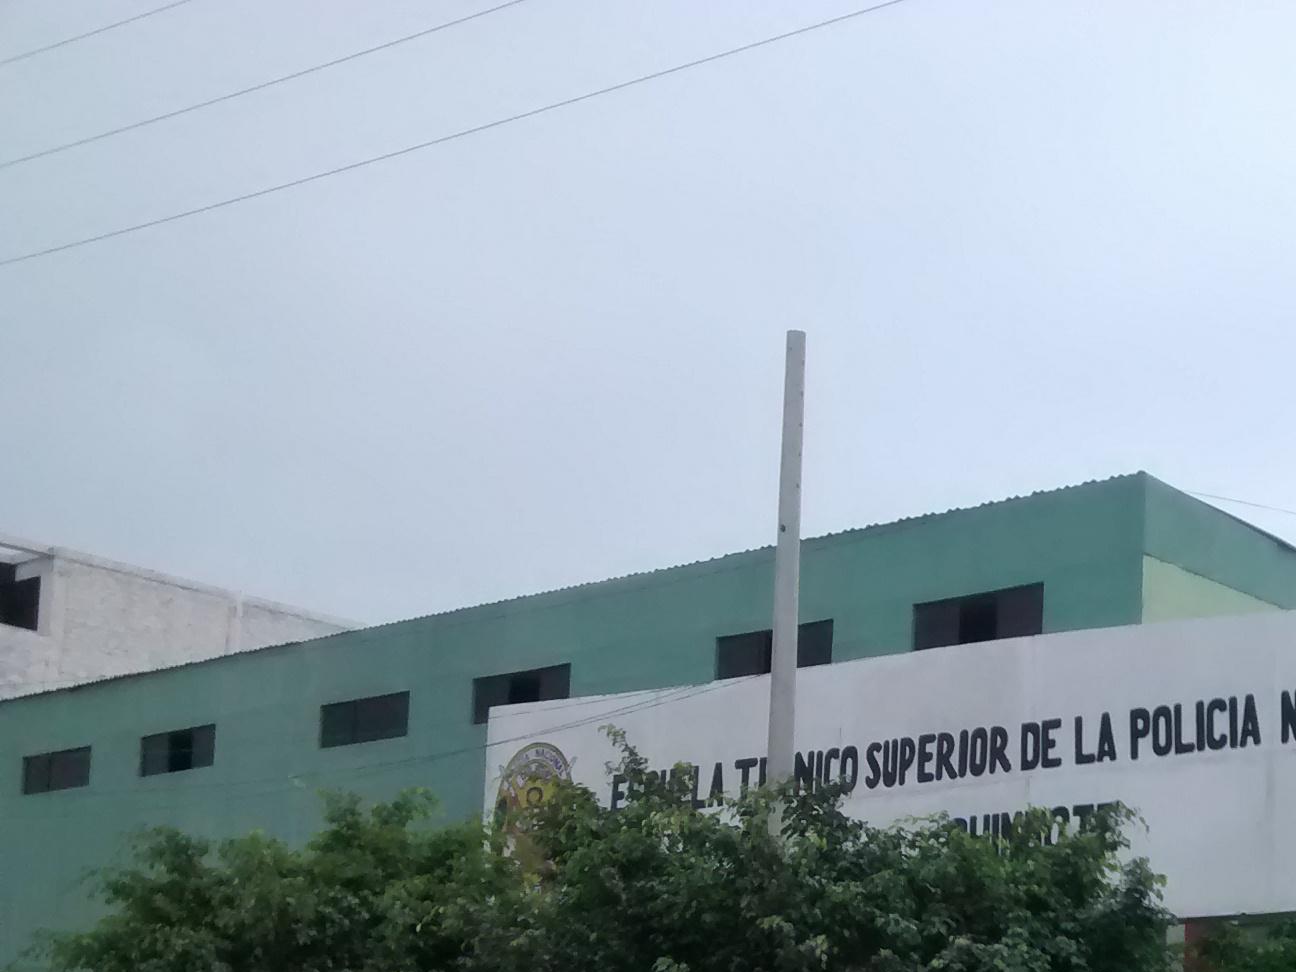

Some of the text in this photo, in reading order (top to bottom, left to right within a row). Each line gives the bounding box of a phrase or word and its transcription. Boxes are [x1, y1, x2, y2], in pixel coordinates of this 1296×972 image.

[734, 744, 859, 801] TNICO
[865, 725, 1012, 788] SUPERIOR
[1020, 718, 1062, 768] DE
[1074, 711, 1117, 765] LA
[1130, 693, 1261, 761] POLICIA
